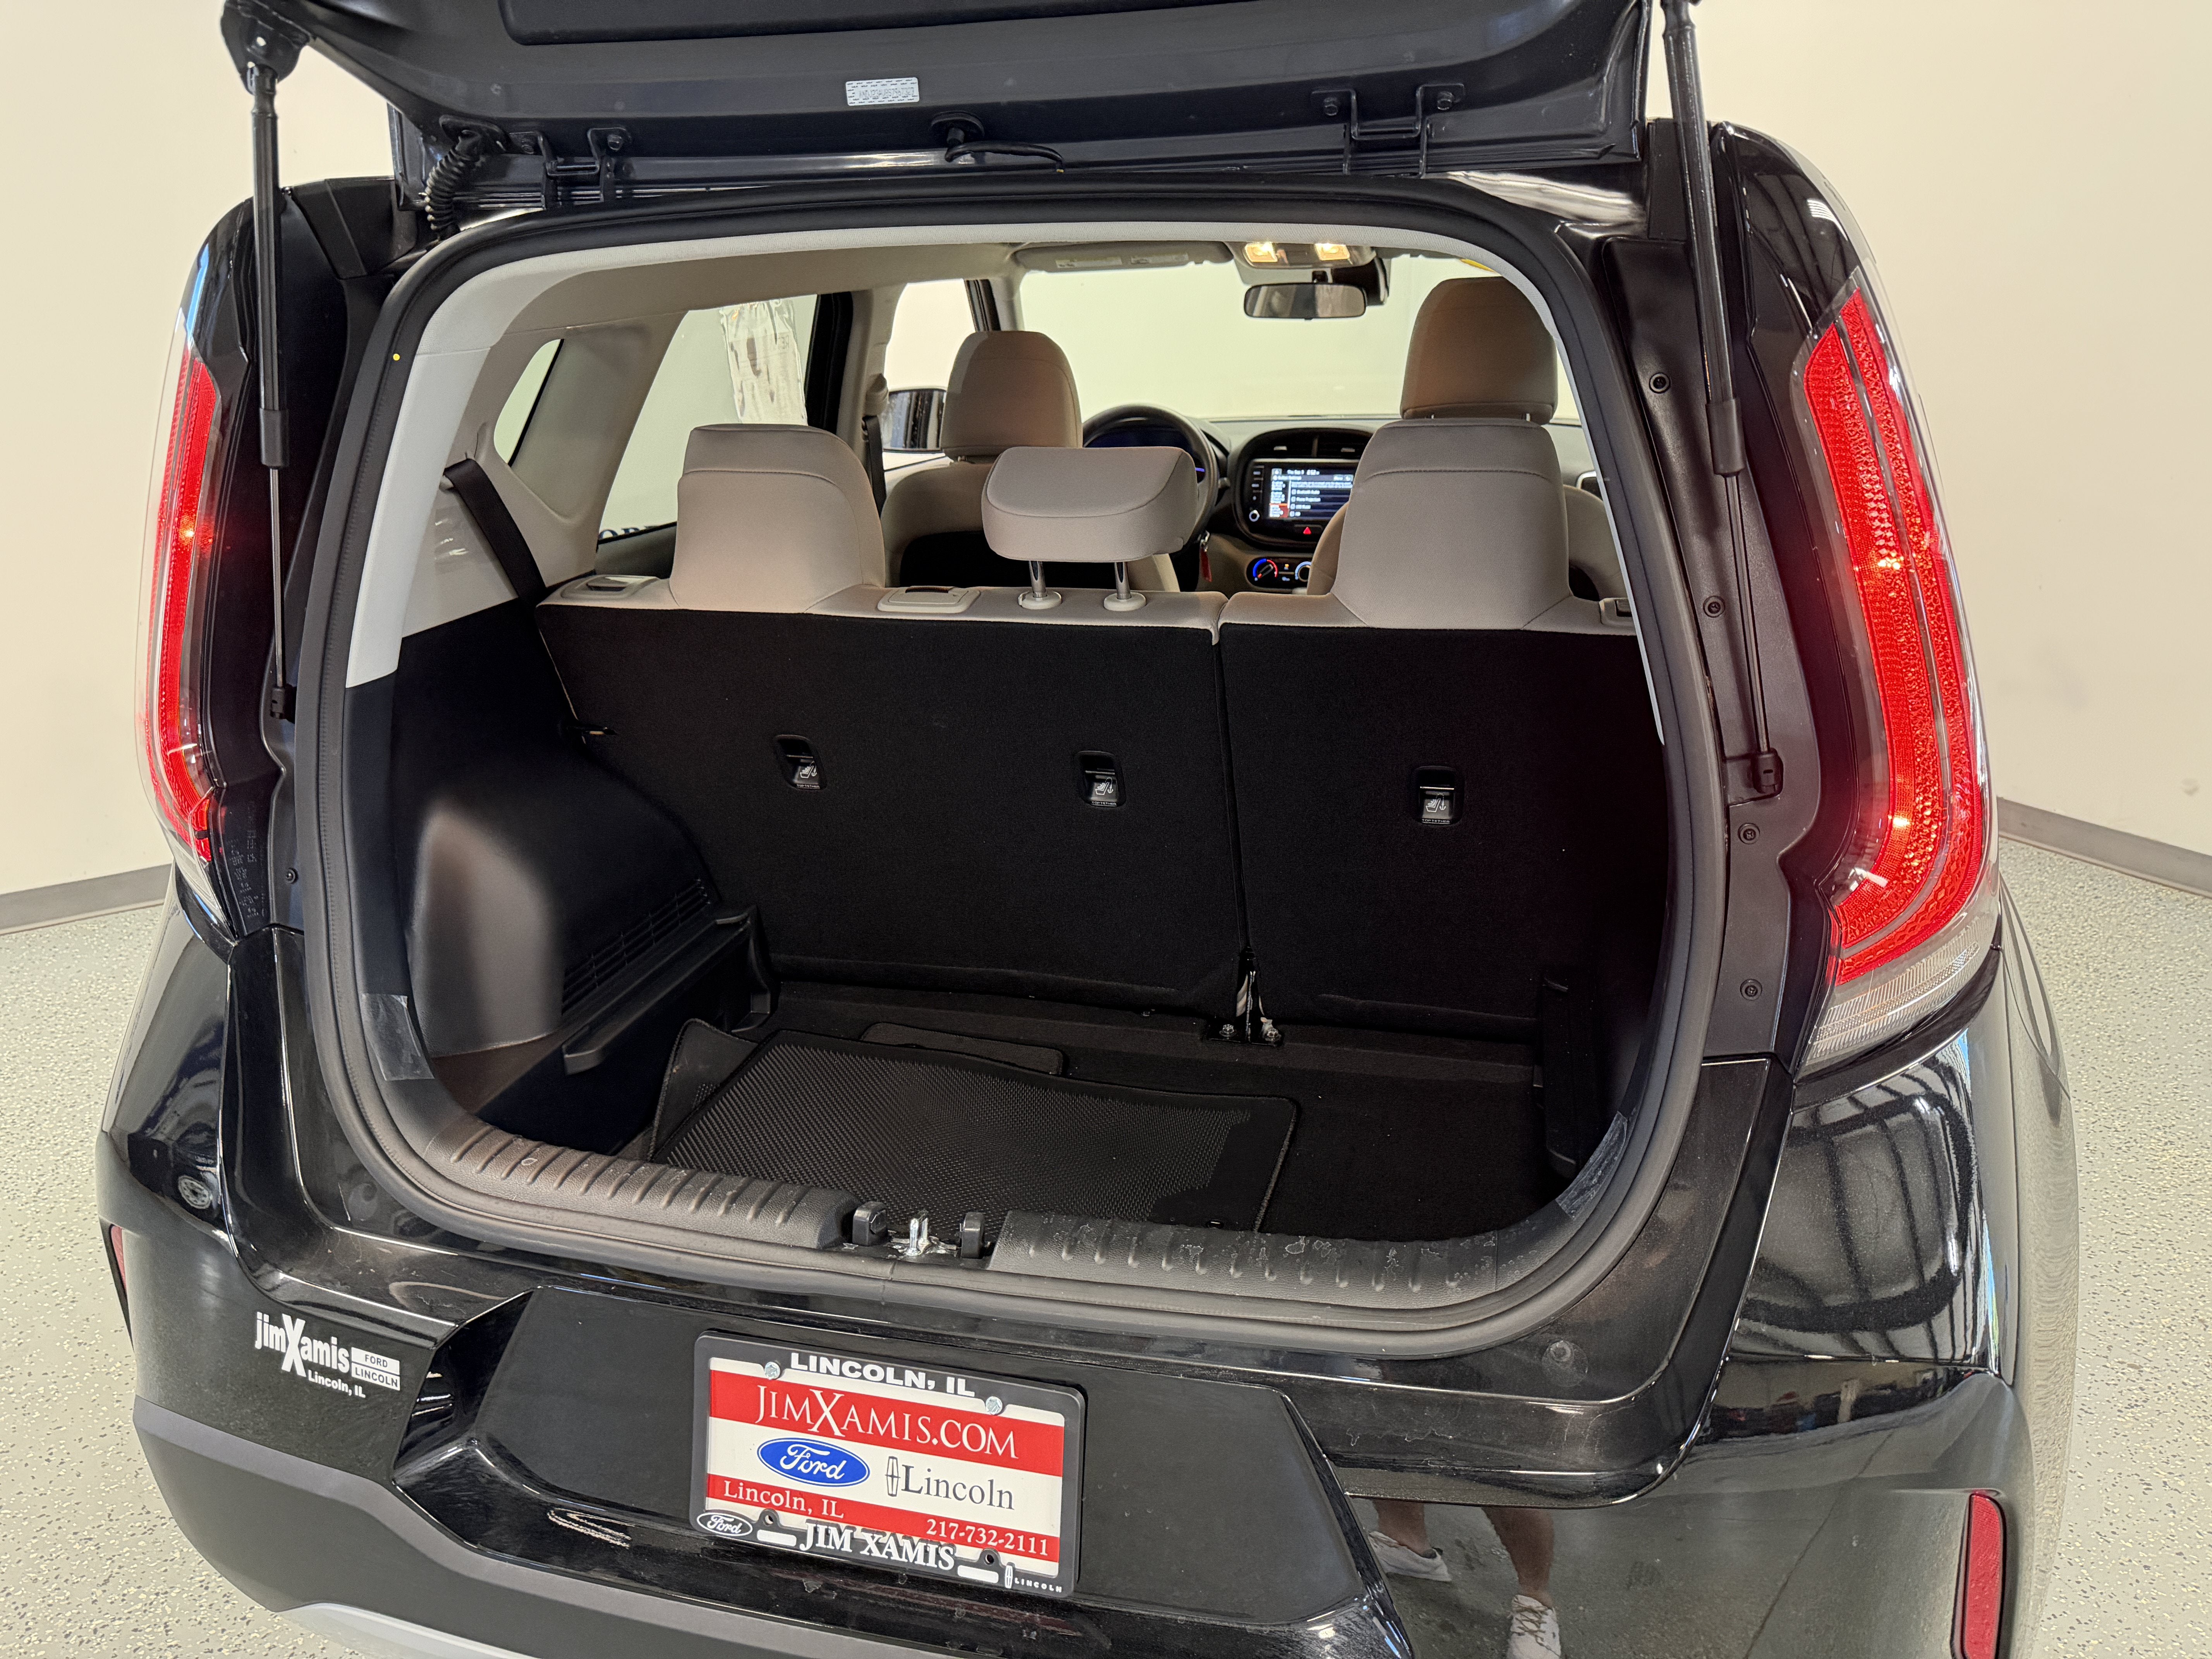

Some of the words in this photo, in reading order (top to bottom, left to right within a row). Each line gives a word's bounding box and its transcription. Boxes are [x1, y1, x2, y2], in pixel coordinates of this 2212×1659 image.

[355, 1367, 398, 1388] LINCOLN
[365, 1354, 388, 1368] FORD
[790, 1352, 936, 1390] LINCOLN,
[946, 1377, 975, 1397] IL
[308, 1369, 352, 1396] Lincoln,
[354, 1385, 366, 1398] IL
[779, 1443, 847, 1481] Ford
[724, 1480, 812, 1515] Lincoln,
[822, 1498, 844, 1519] IL
[901, 1464, 1015, 1510] Lincoln
[706, 1515, 742, 1534] Ford
[926, 1518, 1048, 1556] 217-732-2111
[799, 1522, 853, 1553] JIM
[860, 1532, 955, 1571] XAMIS
[1014, 1577, 1062, 1593] LINCOLN
